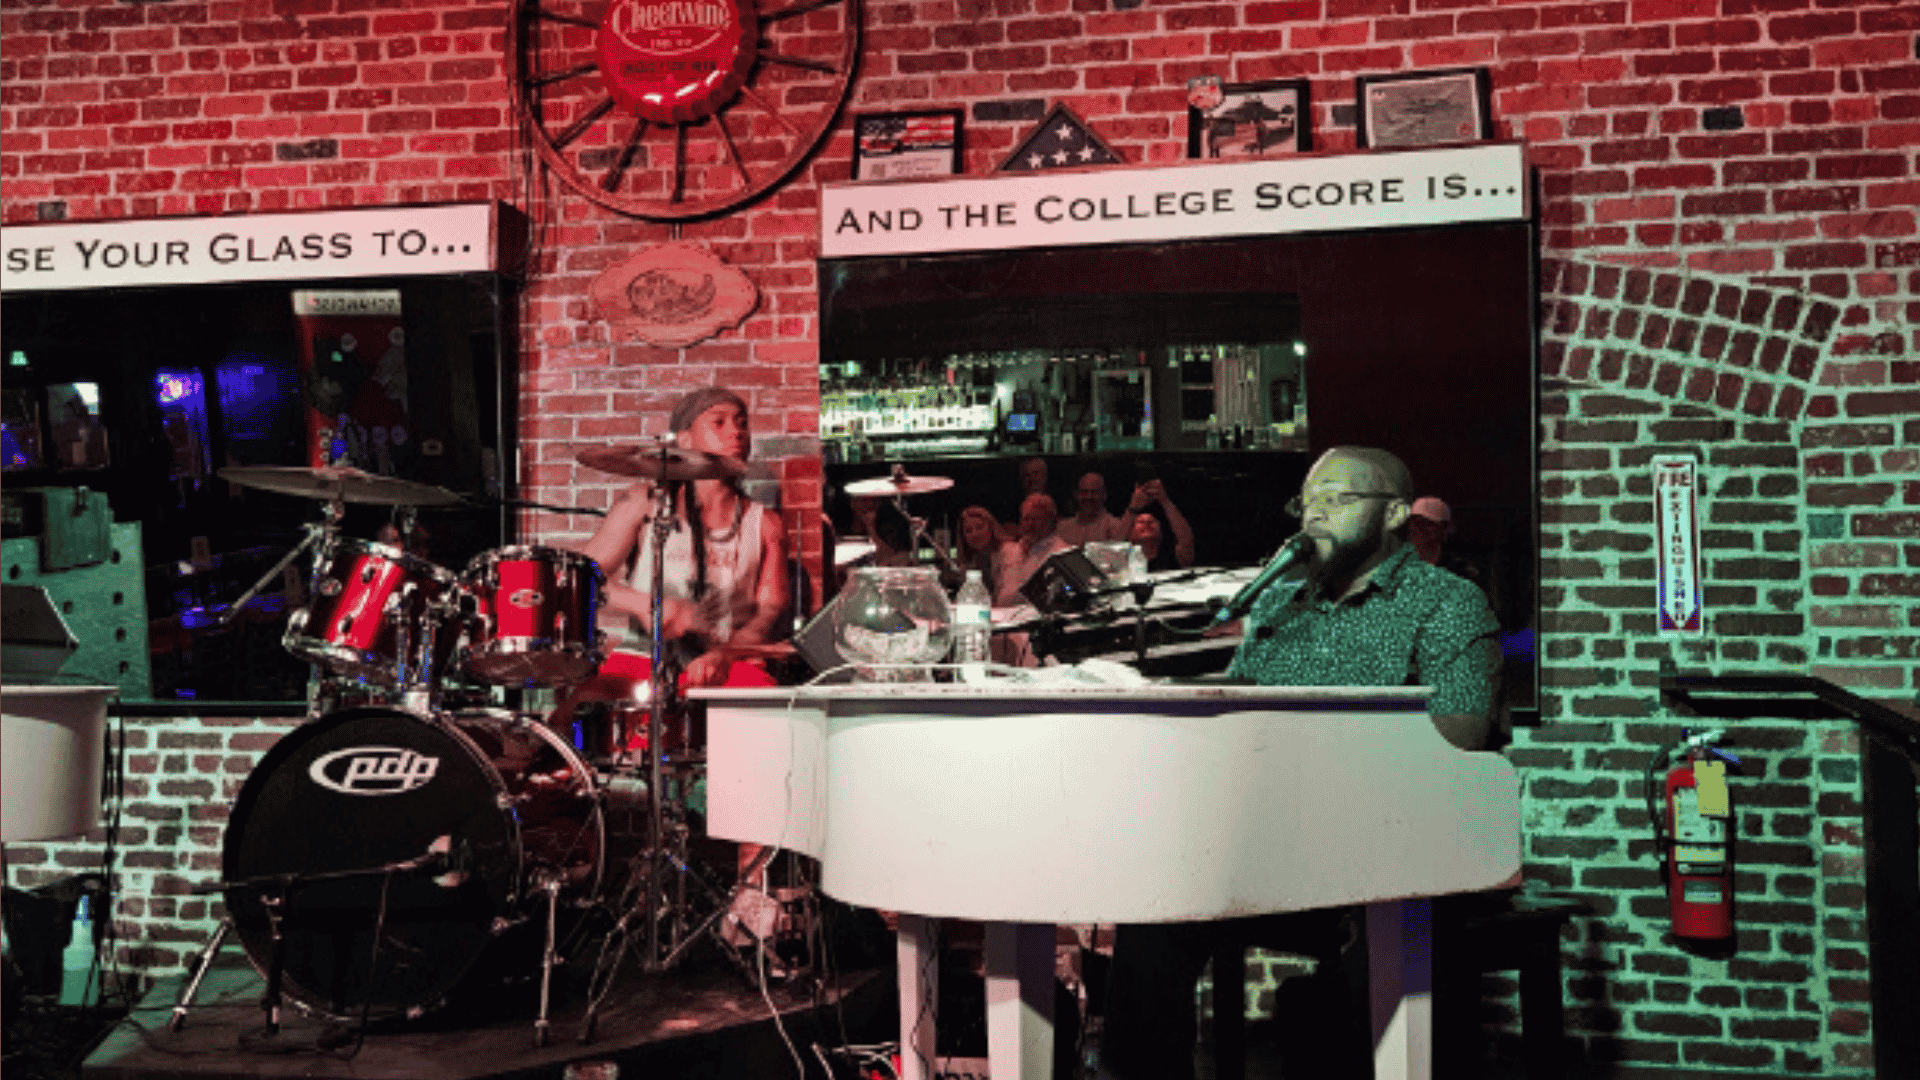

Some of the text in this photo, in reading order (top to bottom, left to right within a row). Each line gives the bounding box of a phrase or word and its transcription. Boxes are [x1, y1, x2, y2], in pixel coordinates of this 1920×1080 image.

[835, 207, 923, 234] AND
[938, 202, 1017, 229] THE
[1034, 188, 1234, 224] COLLEGE
[1254, 178, 1404, 210] SCORE
[74, 238, 190, 270] YOUR
[208, 232, 353, 264] GLASS
